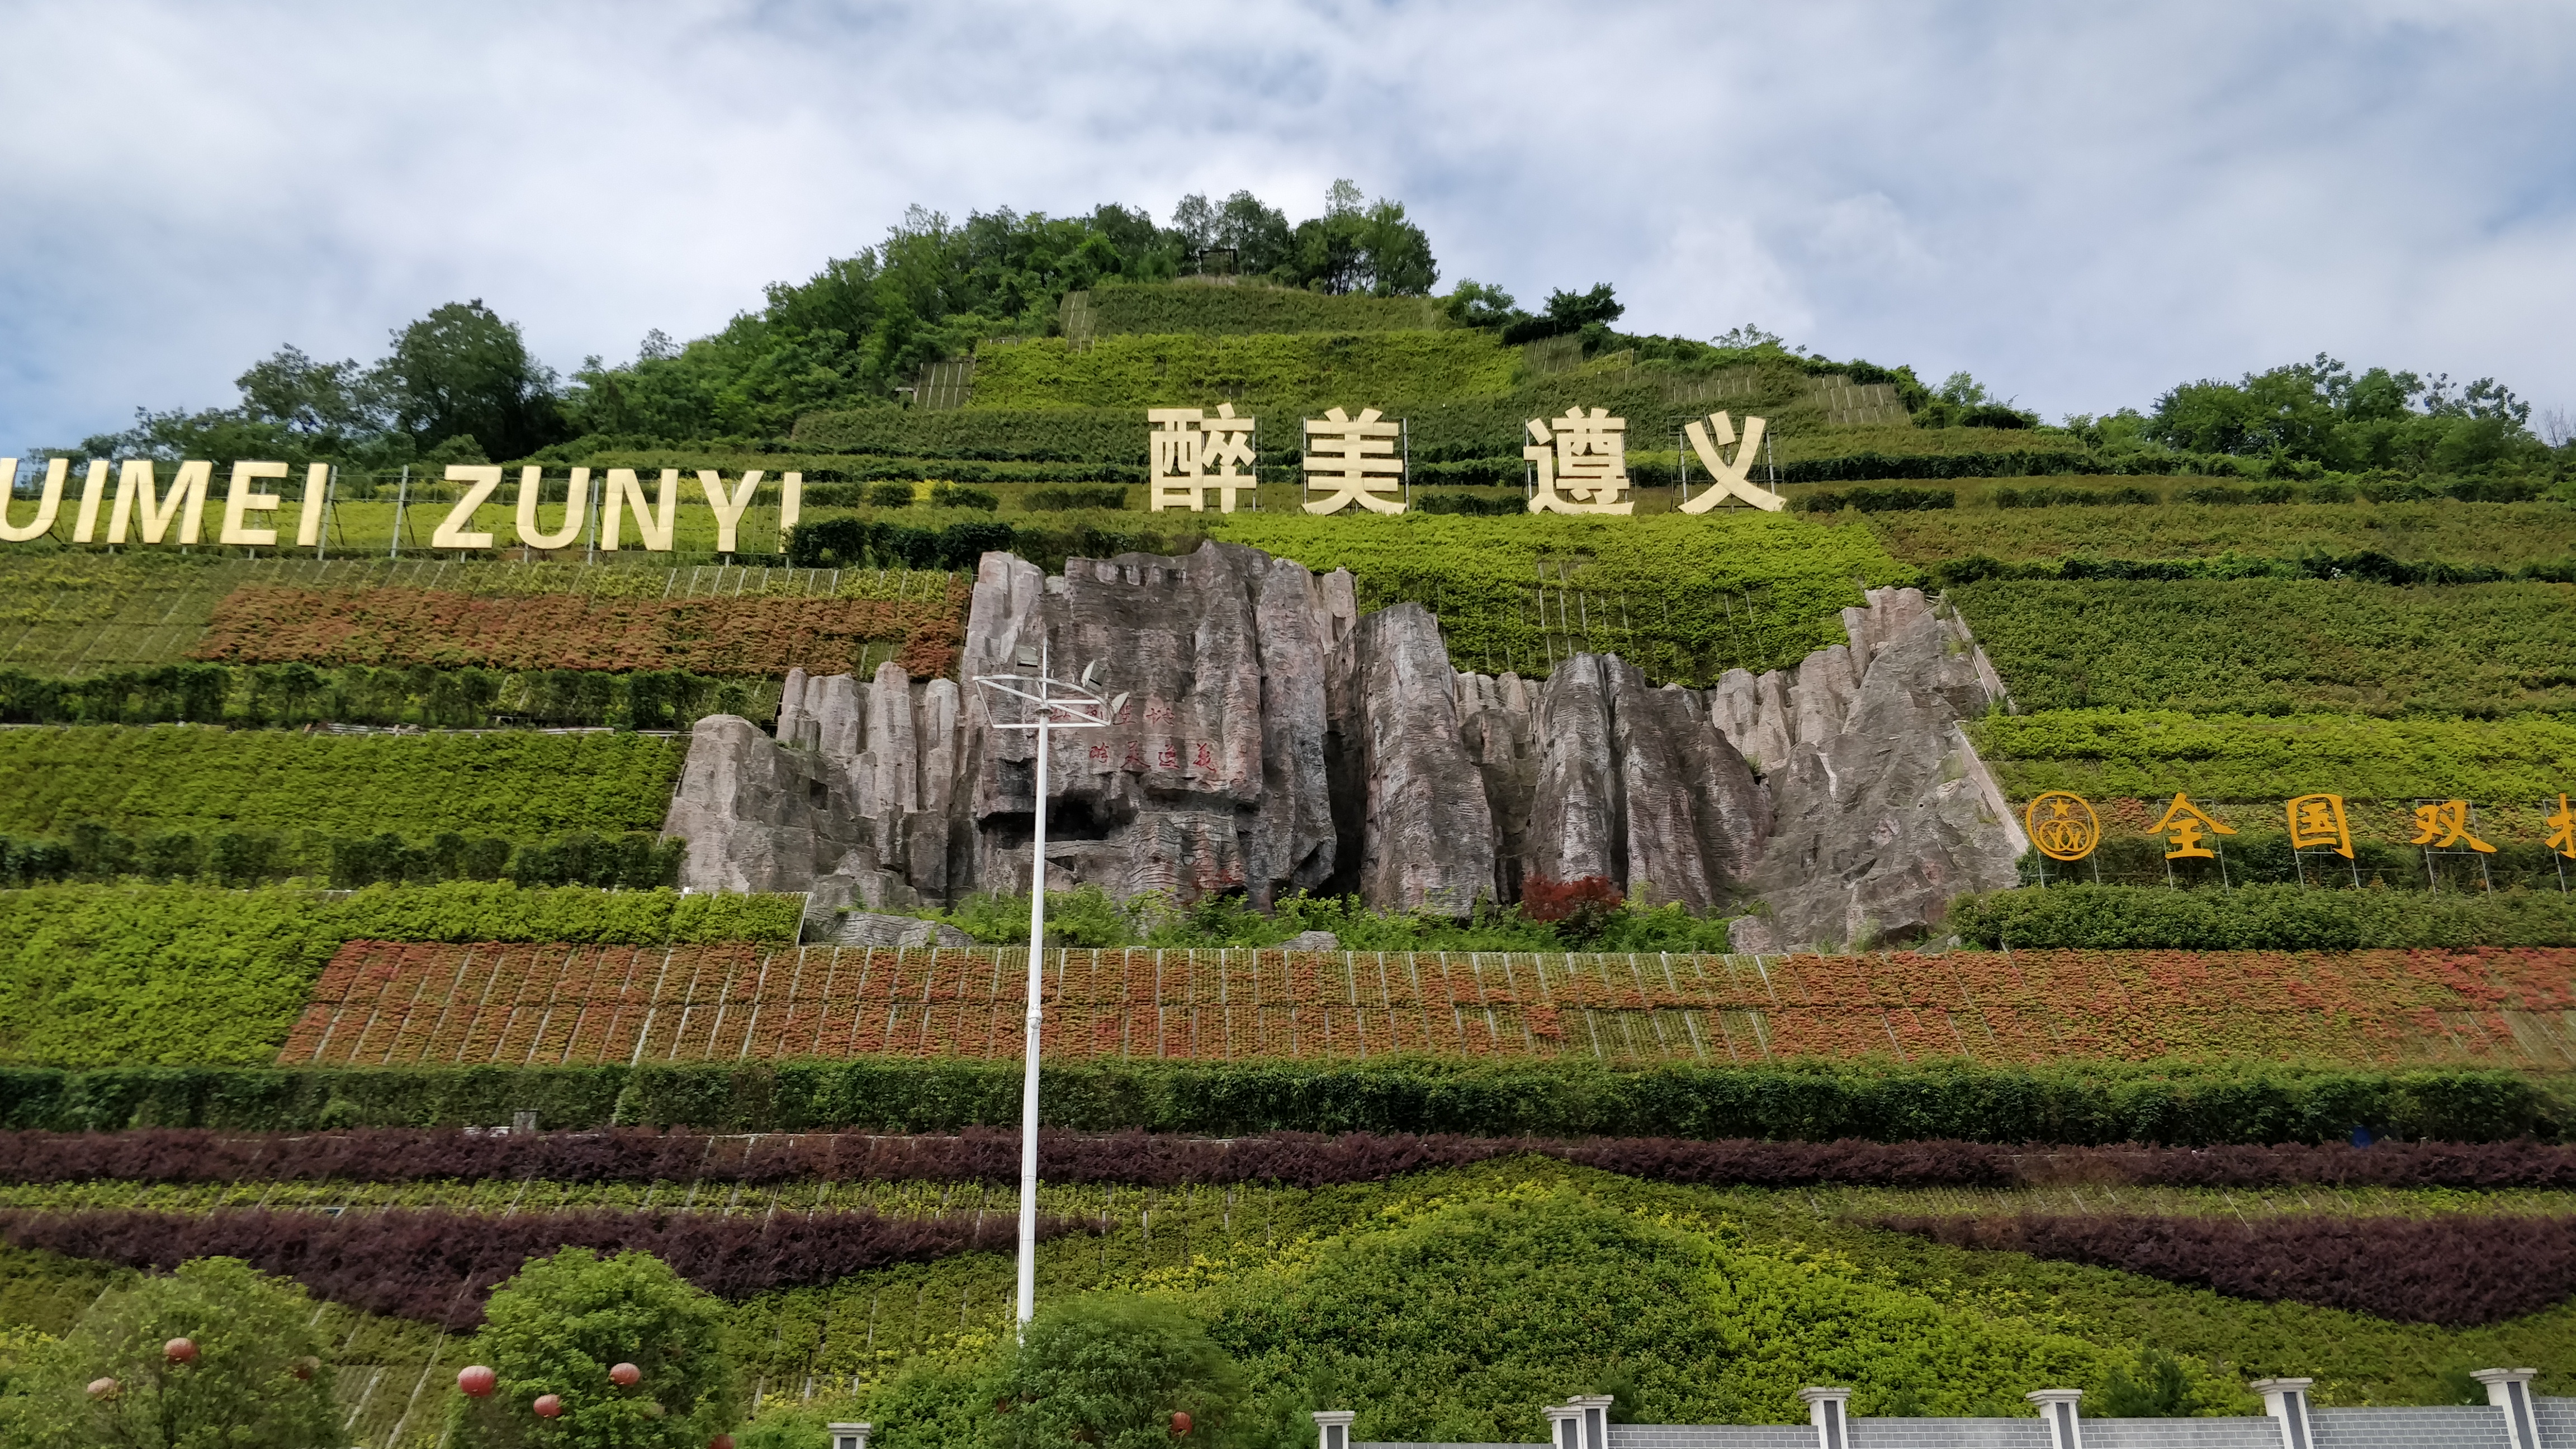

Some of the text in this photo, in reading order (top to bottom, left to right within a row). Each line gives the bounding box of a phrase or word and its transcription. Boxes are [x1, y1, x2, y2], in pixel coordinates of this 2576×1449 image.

[0, 457, 803, 553] UIMEI ZUNYI
[1148, 402, 1787, 515] 醉美遵义
